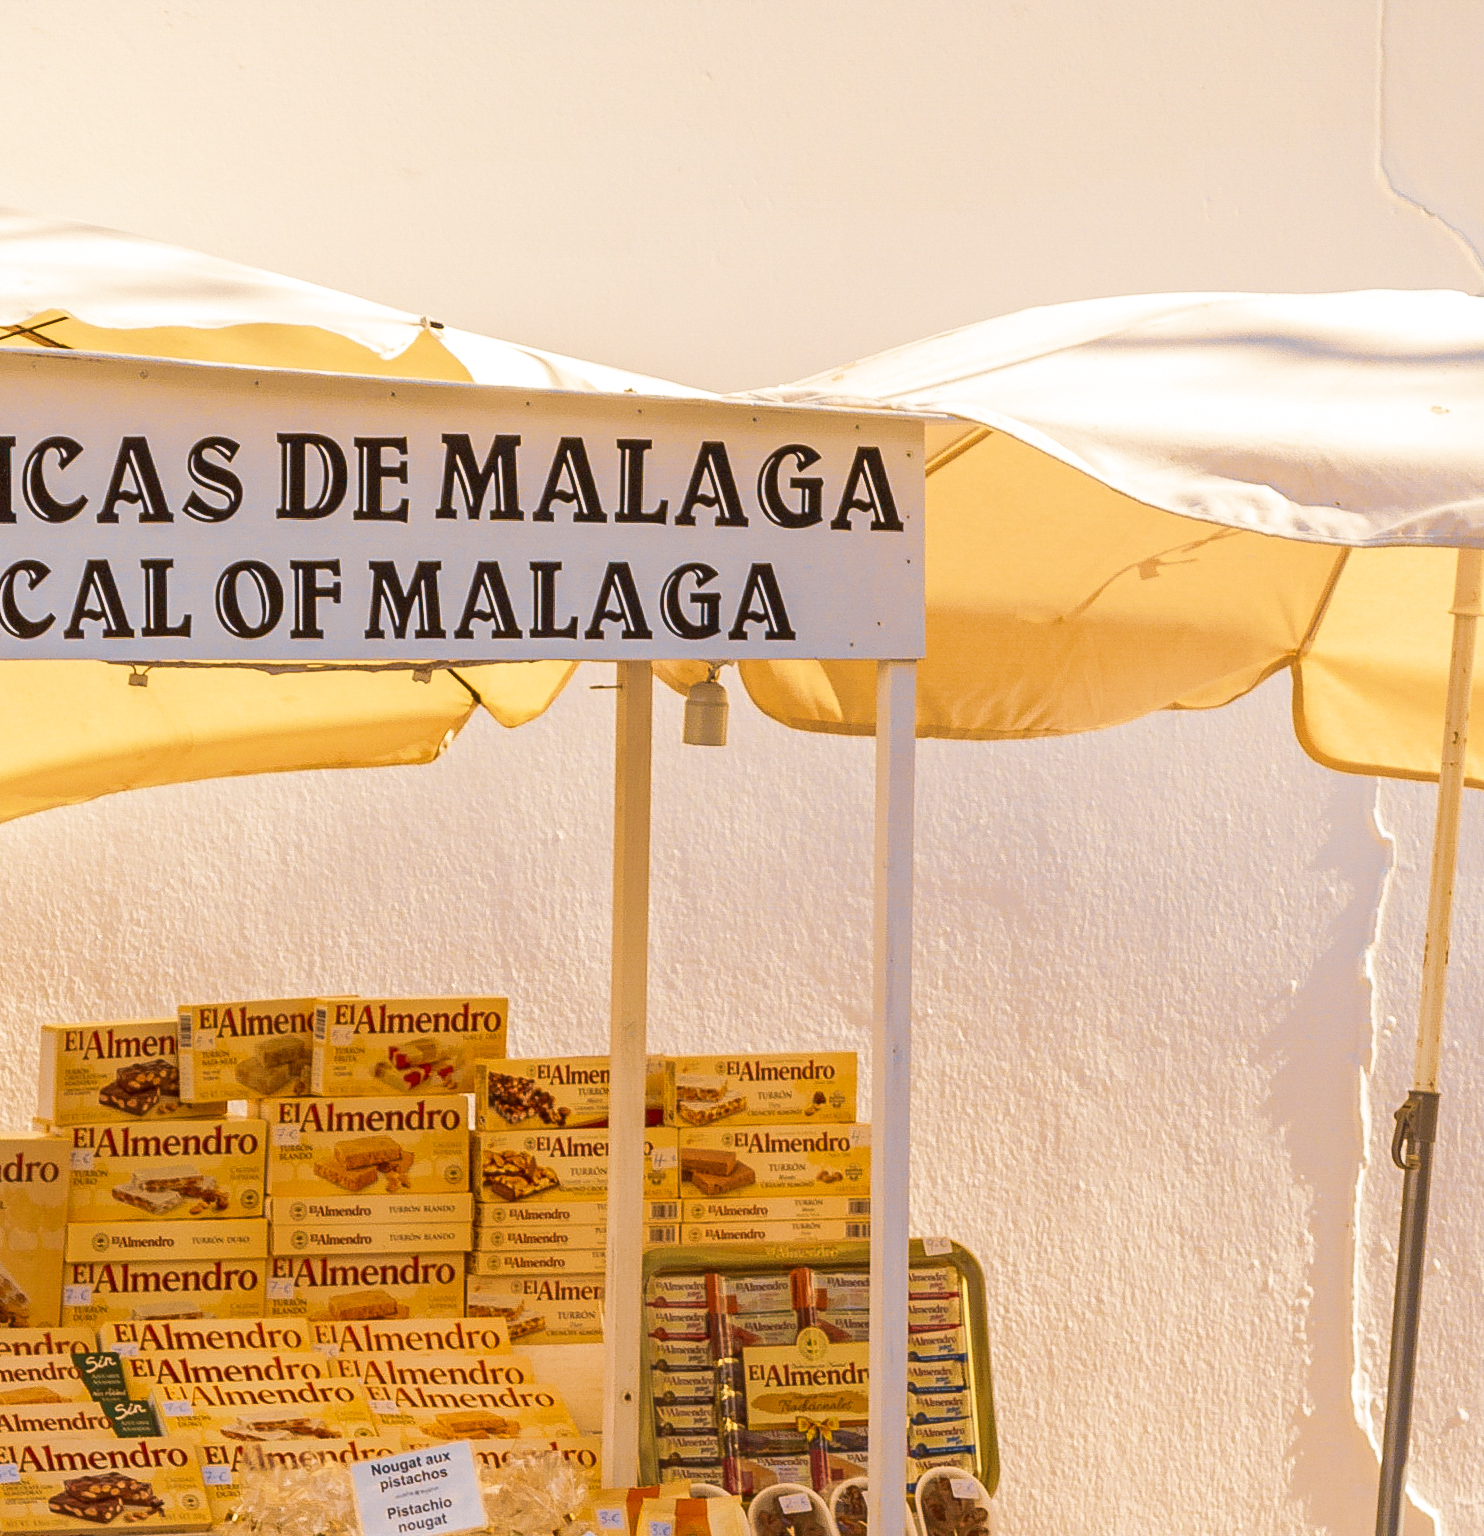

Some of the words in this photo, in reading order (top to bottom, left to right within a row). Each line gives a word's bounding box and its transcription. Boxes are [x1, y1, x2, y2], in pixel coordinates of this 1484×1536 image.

[275, 432, 409, 523] DE
[435, 433, 905, 532] MALAGA
[214, 558, 342, 640] OF
[364, 560, 796, 643] MALAGA
[334, 1004, 355, 1025] El
[353, 1003, 501, 1034] Almendro
[83, 1028, 176, 1060] Almen
[550, 1062, 609, 1085] Almen
[727, 1061, 740, 1075] El
[739, 1060, 835, 1081] Almendro
[279, 1103, 300, 1123] El
[299, 1101, 460, 1132] Almendro
[73, 1128, 94, 1148] El
[93, 1125, 258, 1157] Almendro
[734, 1133, 748, 1147] El
[748, 1131, 850, 1153] Almendro
[73, 1264, 94, 1284] El
[93, 1262, 258, 1293] Almendro
[272, 1258, 294, 1278] El
[294, 1255, 456, 1288] Almendro
[113, 1323, 137, 1342] El
[139, 1321, 302, 1351] Almendro
[315, 1326, 337, 1344] El
[339, 1323, 500, 1352] Almendro
[85, 1356, 116, 1373] Sin
[130, 1359, 154, 1377] El
[156, 1356, 321, 1384] Almendro
[338, 1360, 360, 1378] El
[364, 1360, 524, 1385] Almendro
[765, 1362, 869, 1387] Almendr
[164, 1386, 187, 1401] El
[192, 1383, 354, 1407] Almendro
[367, 1386, 390, 1400] El
[394, 1386, 555, 1408] Almendro
[115, 1403, 146, 1420] Sin
[19, 1441, 188, 1472] Almendro
[371, 1456, 422, 1476] Nougat
[426, 1452, 451, 1465] aux
[380, 1467, 448, 1492] pistachos
[387, 1497, 452, 1519] Pistachio
[398, 1513, 447, 1533] nougat
